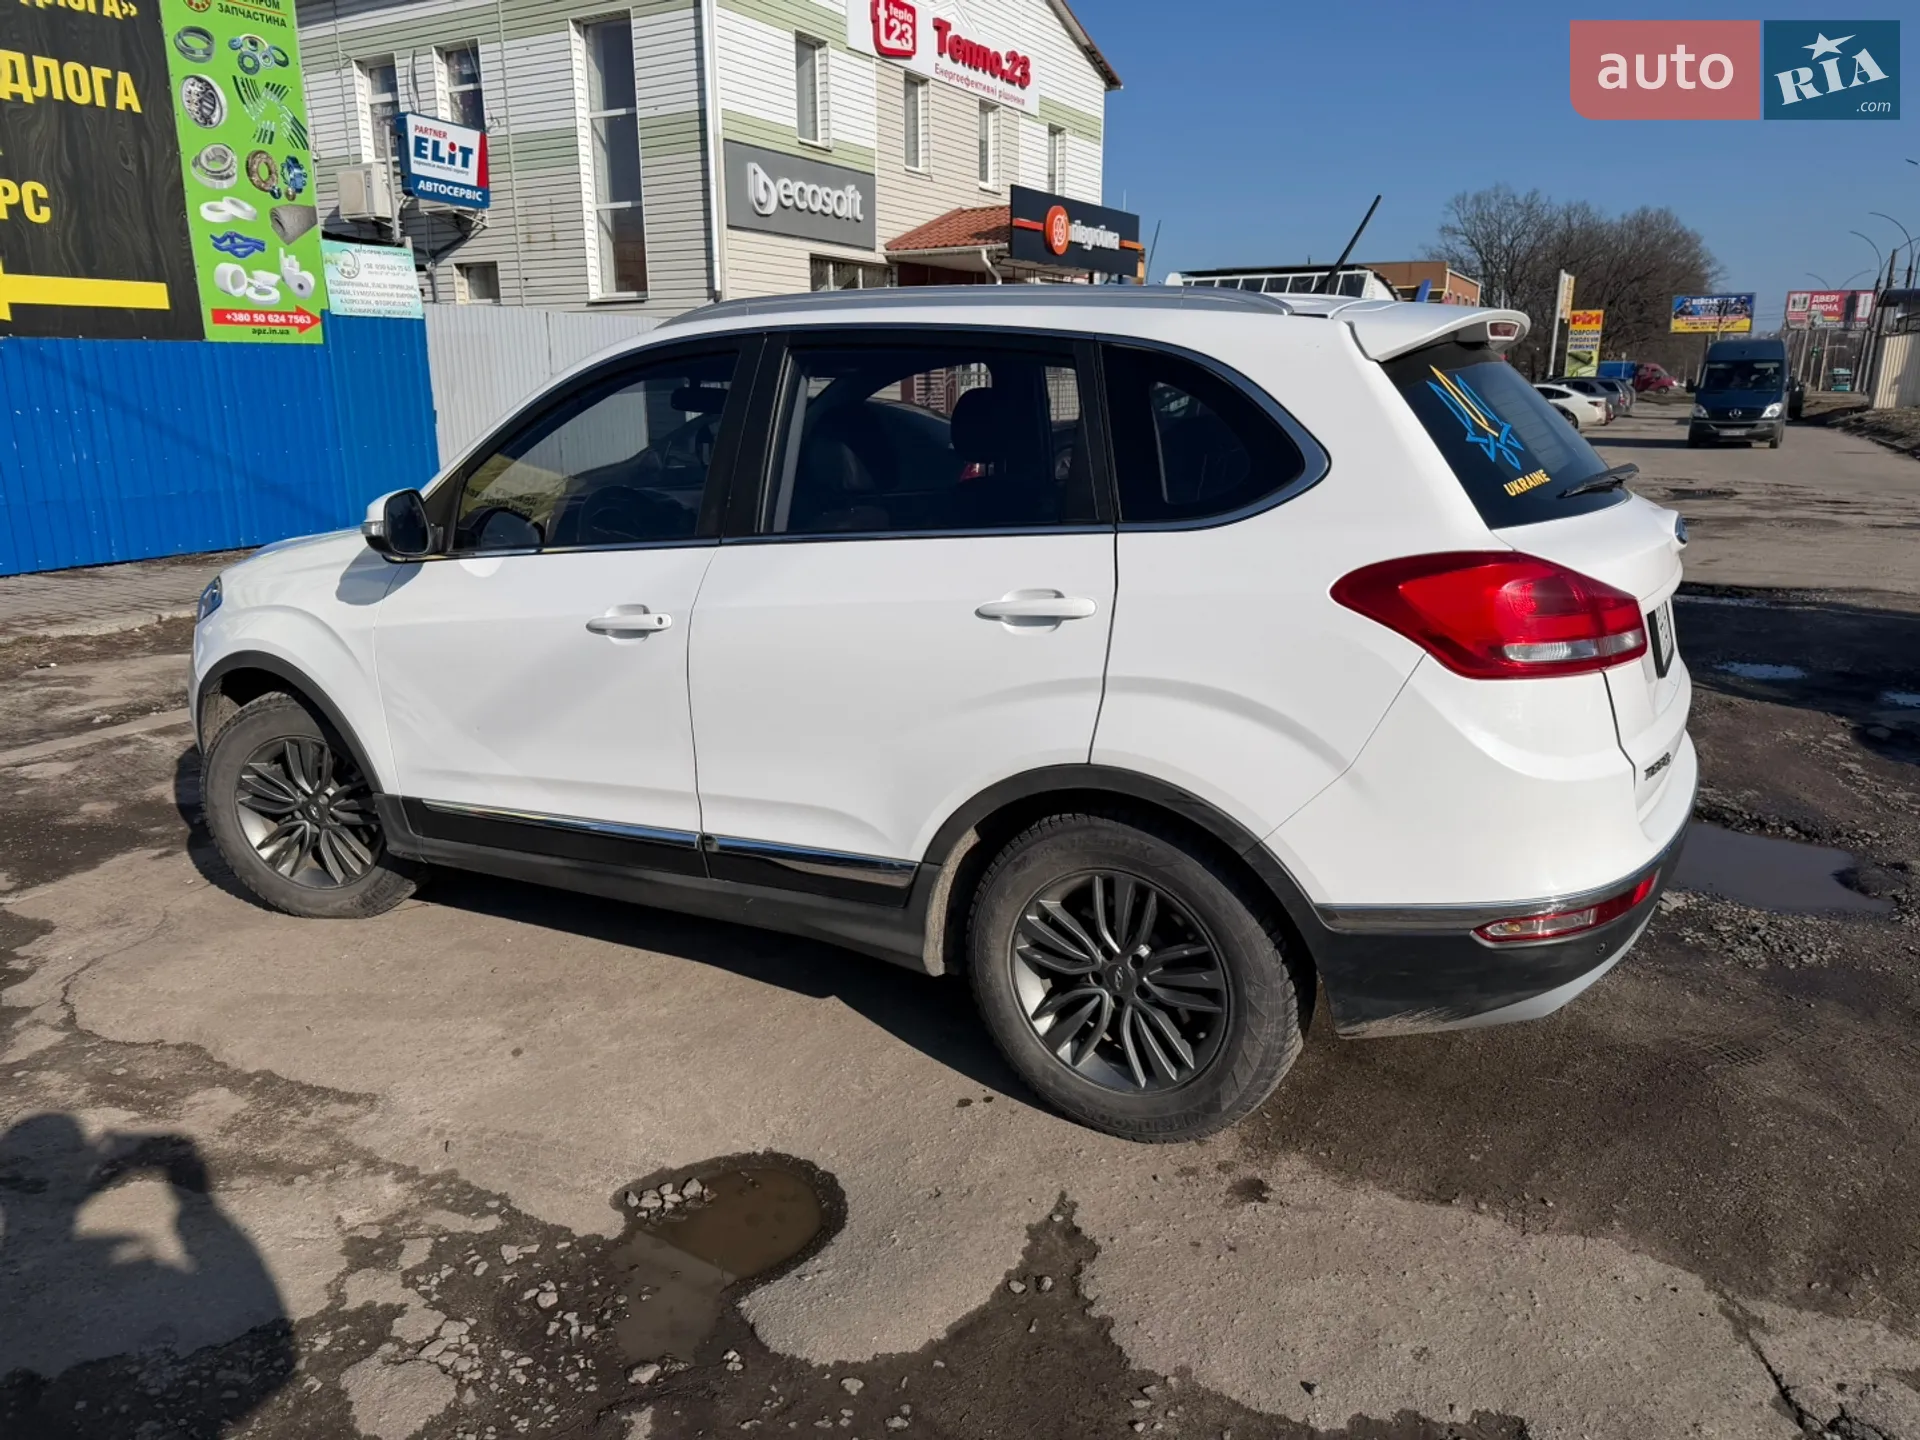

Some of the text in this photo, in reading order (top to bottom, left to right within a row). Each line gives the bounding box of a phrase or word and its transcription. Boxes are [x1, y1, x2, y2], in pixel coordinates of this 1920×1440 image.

[218, 3, 287, 28] ЗАПЧАСТИНА
[889, 2, 913, 23] teplo
[889, 18, 913, 48] 23
[414, 125, 448, 139] PARTNER
[418, 180, 483, 202] АВТОСЕРВІС
[777, 178, 865, 222] ecosoft
[225, 312, 251, 322] +380
[1503, 469, 1551, 496] UKRAINE
